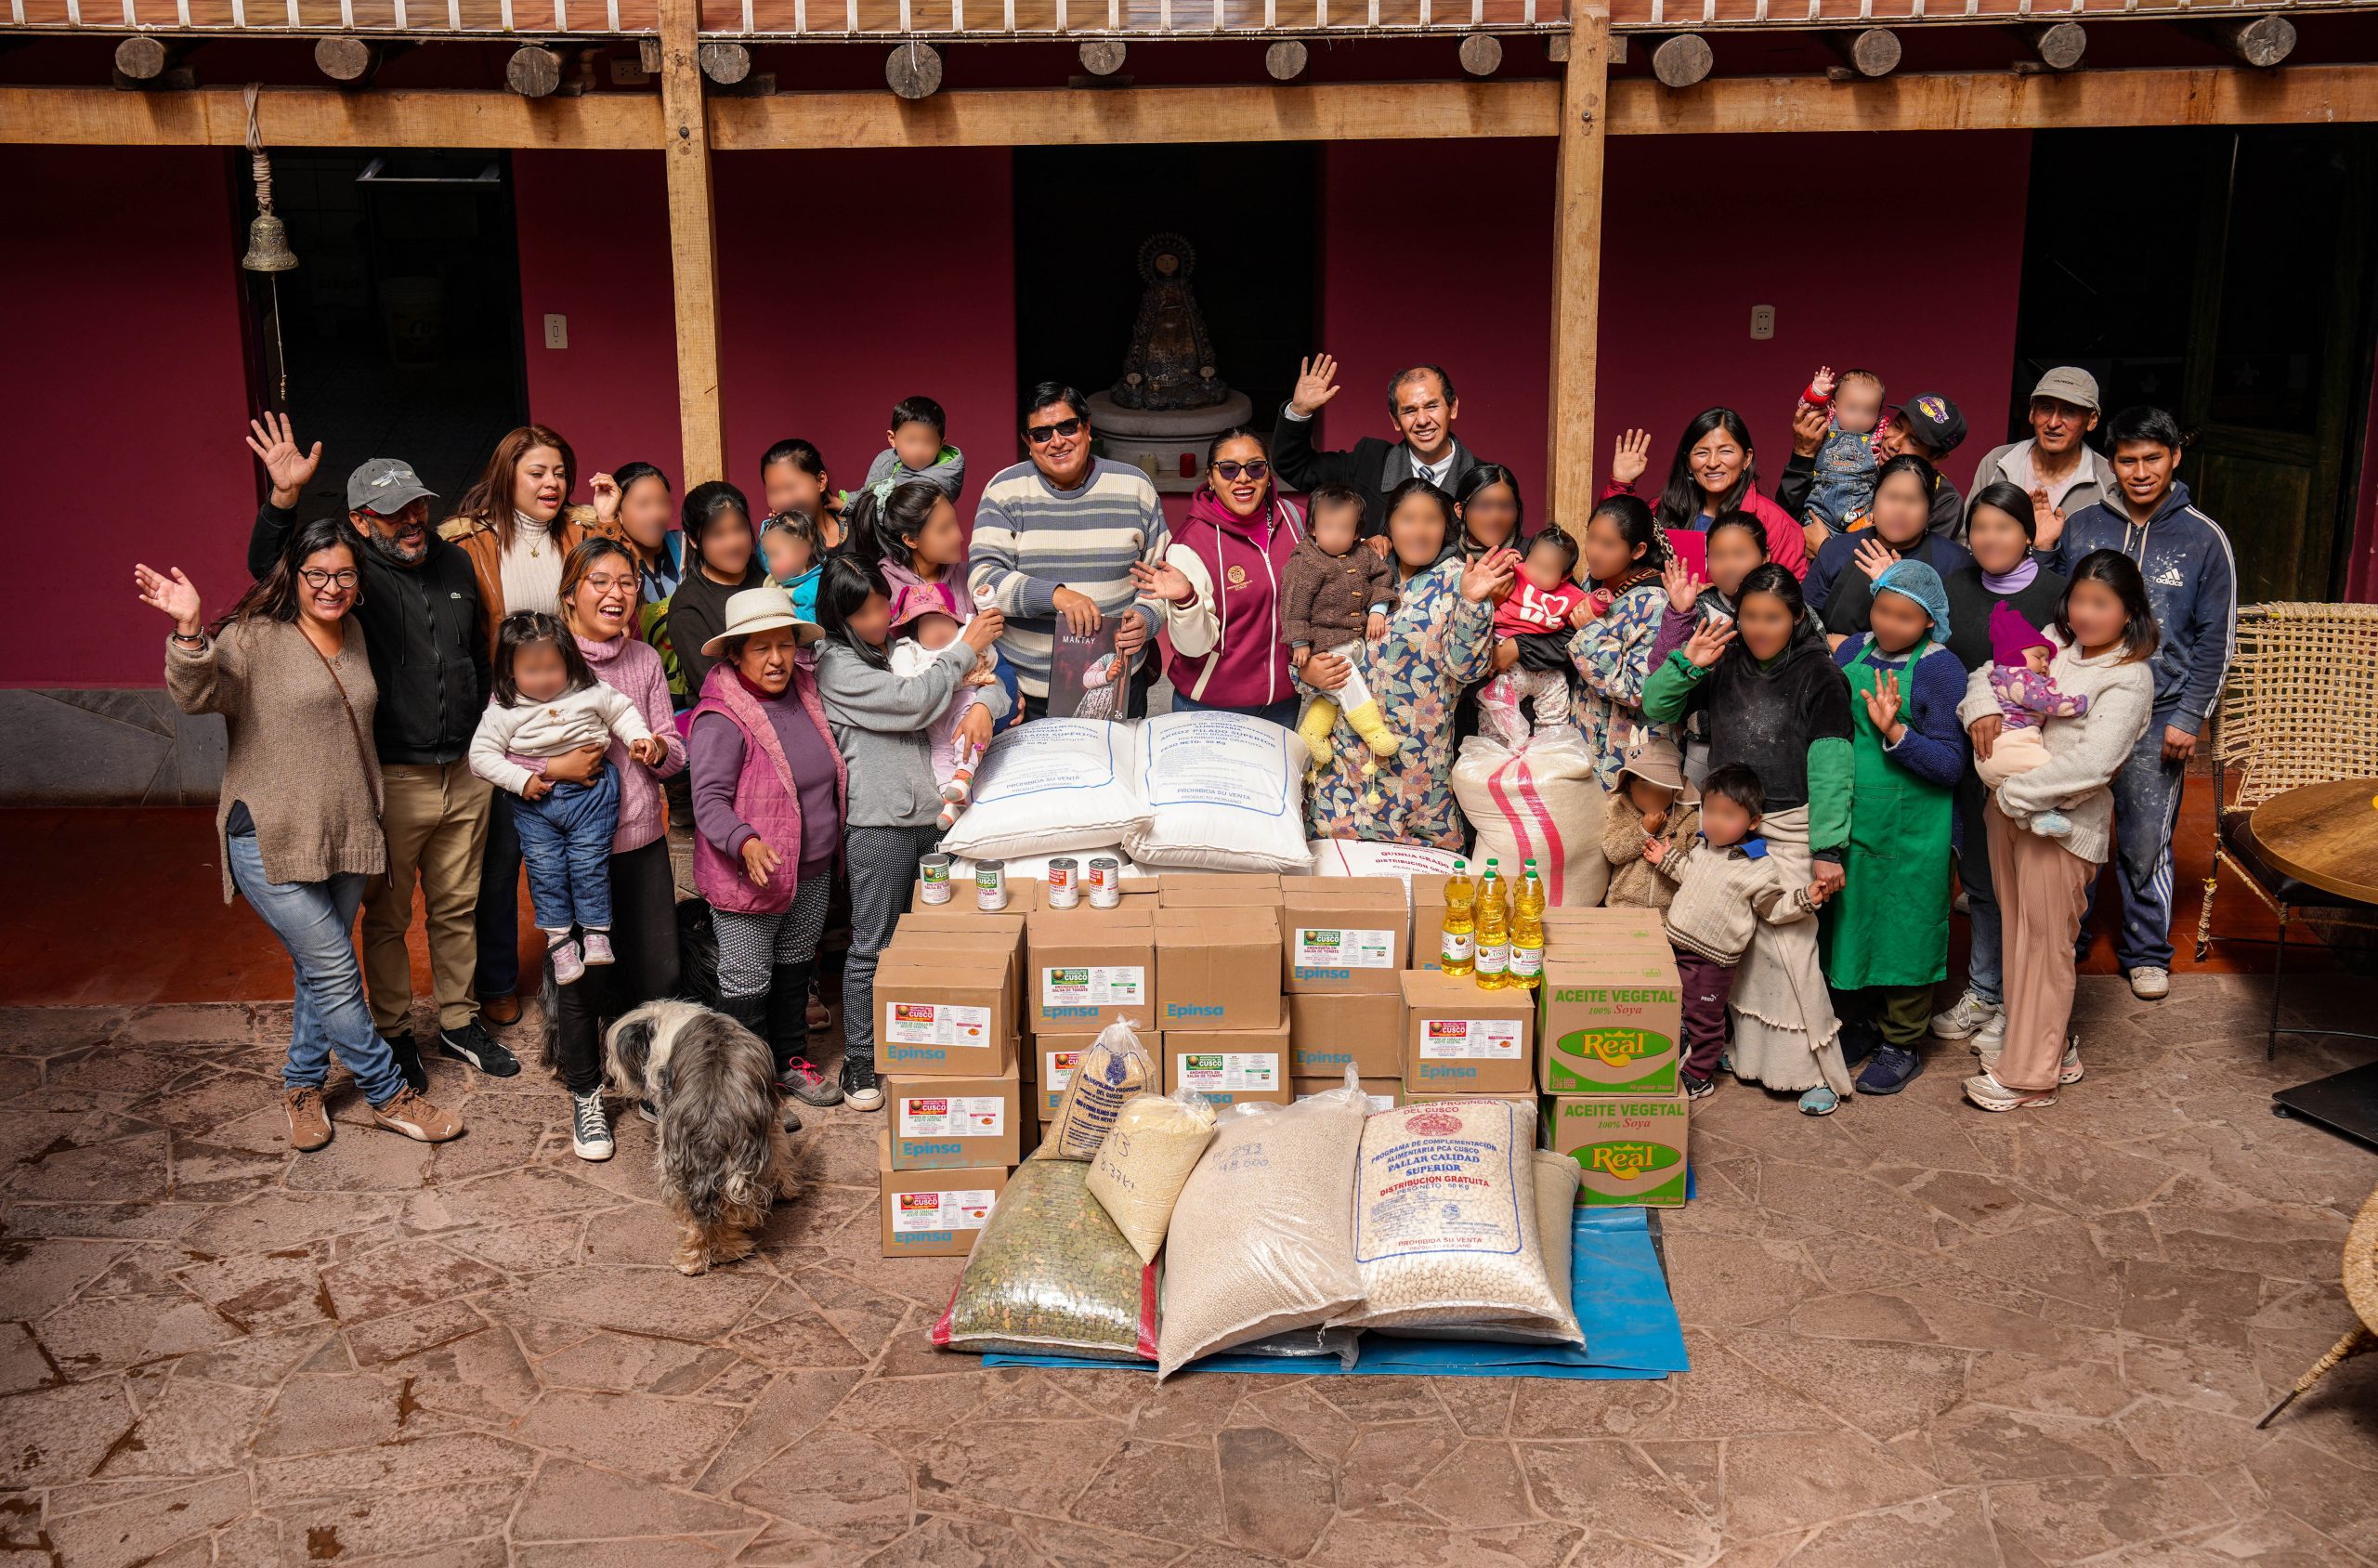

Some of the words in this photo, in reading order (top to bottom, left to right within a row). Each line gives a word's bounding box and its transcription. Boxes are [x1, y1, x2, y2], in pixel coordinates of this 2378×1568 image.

[2156, 578, 2183, 587] adidas
[1062, 635, 1096, 645] MANTAY
[1114, 710, 1123, 719] 25
[1231, 730, 1276, 749] SUPERIOR
[1006, 778, 1044, 789] PROHIBIDA
[1212, 796, 1242, 804] PERUANO
[1228, 791, 1251, 801] VENTA
[1418, 856, 1449, 869] GRADO
[977, 877, 997, 885] CUSCO
[1295, 966, 1350, 981] Epinsa
[1555, 990, 1607, 1002] ACEITE
[1612, 990, 1678, 1003] VEGETAL
[1042, 1006, 1099, 1018] Epinsa
[1168, 1003, 1224, 1019] Epinsa
[1589, 1007, 1612, 1015] 100%
[1614, 1004, 1642, 1017] Soya
[887, 1045, 947, 1061] Epinsa
[1583, 1032, 1644, 1067] Real
[1296, 1050, 1352, 1065] Epinsa
[1420, 1064, 1477, 1078] Epinsa
[1096, 1089, 1105, 1097] DEL
[1106, 1091, 1123, 1100] CUSCO
[1564, 1104, 1615, 1117] ACEITE
[1620, 1104, 1685, 1117] VEGETAL
[1598, 1120, 1621, 1129] 100%
[1623, 1117, 1651, 1130] Soya
[903, 1142, 961, 1156] Epinsa
[1371, 1143, 1410, 1164] PROGRAMA
[1387, 1146, 1434, 1164] ALIMENTARIA
[1388, 1156, 1428, 1173] PALLAR
[1431, 1154, 1480, 1164] CALIDAD
[1592, 1144, 1653, 1181] Real
[1405, 1164, 1462, 1177] SUPERIOR
[1444, 1176, 1490, 1188] GRATUITA
[1397, 1185, 1418, 1196] PESO
[1418, 1183, 1442, 1191] NETO
[895, 1232, 952, 1245] Epinsa
[1399, 1238, 1440, 1247] PROHIBIDA
